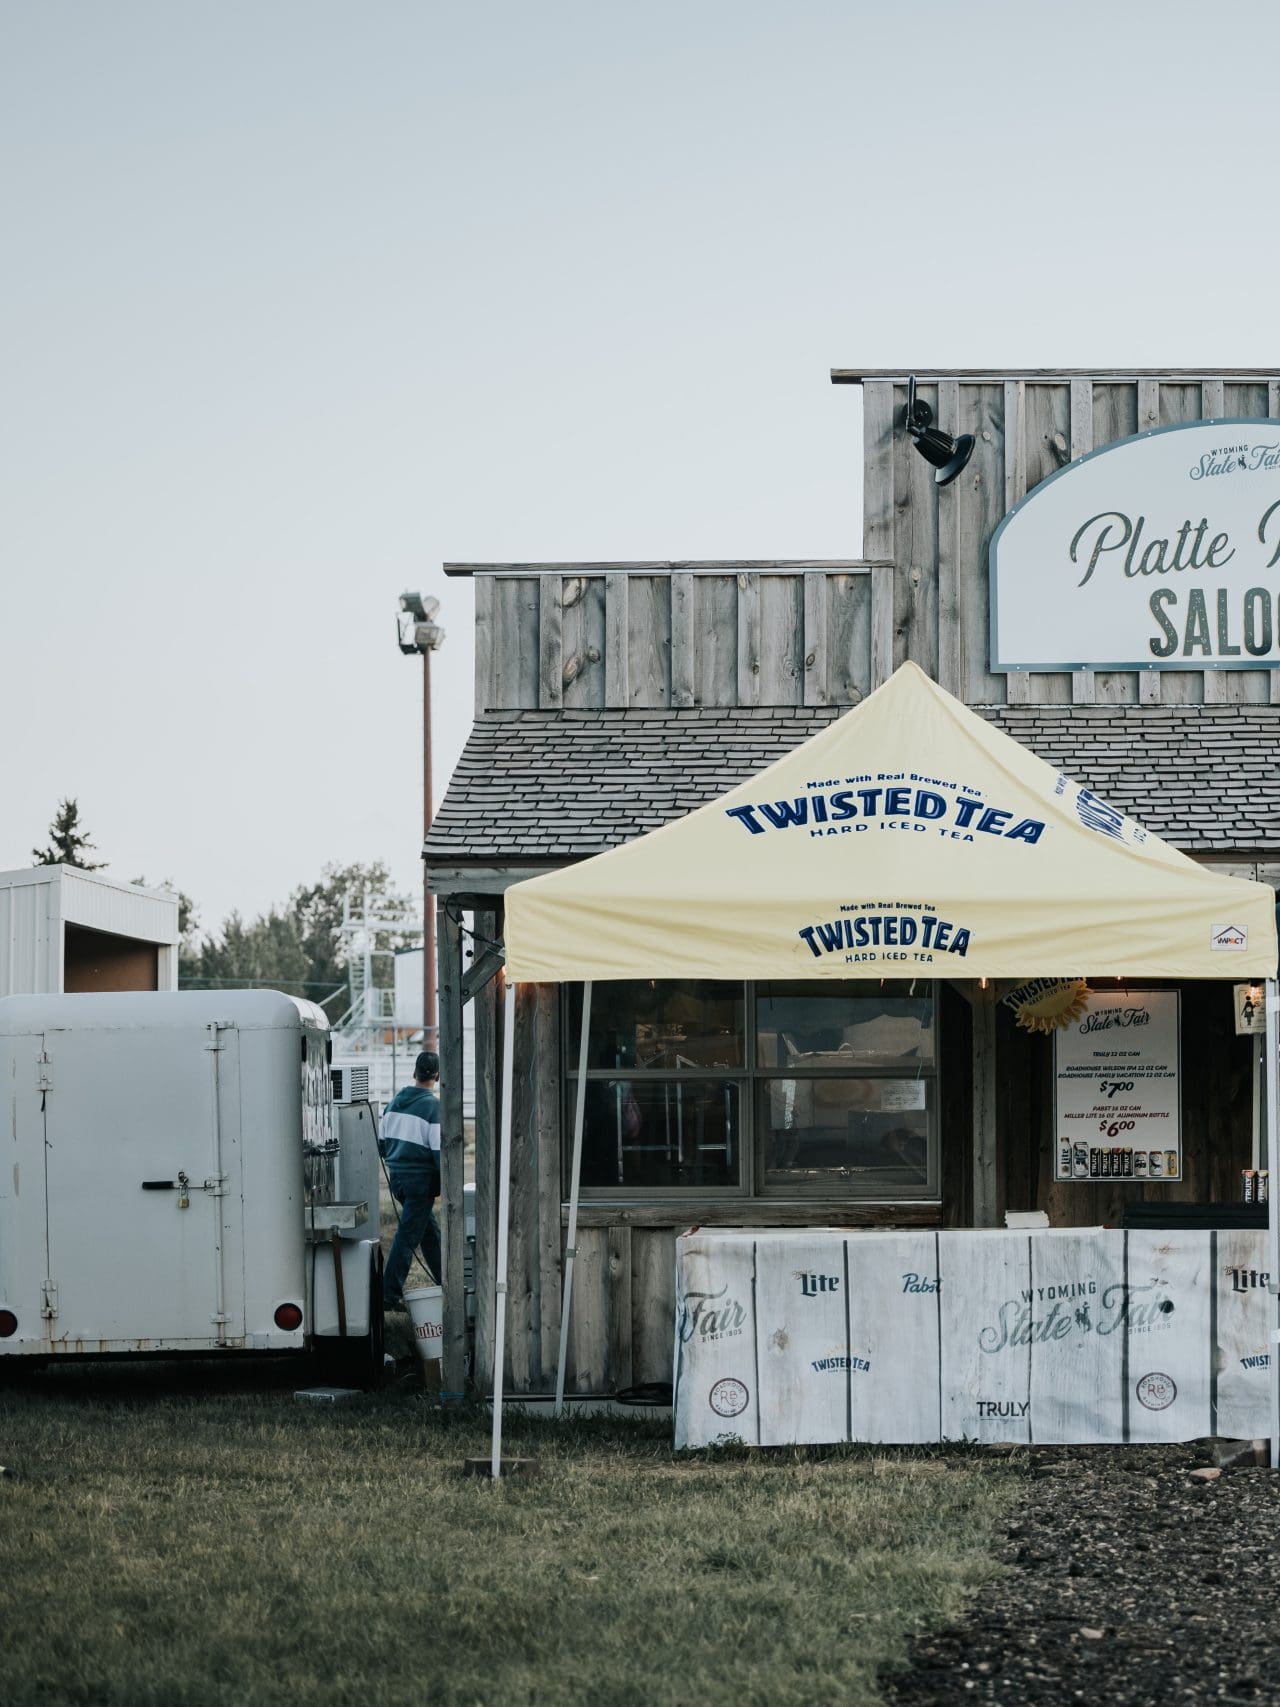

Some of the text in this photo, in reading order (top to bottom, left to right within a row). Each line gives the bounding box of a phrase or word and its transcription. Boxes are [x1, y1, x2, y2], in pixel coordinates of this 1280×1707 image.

[1210, 444, 1249, 456] WYOMING
[1189, 453, 1237, 480] State
[1069, 510, 1235, 587] Platte
[806, 773, 982, 797] Made with Real Brewed Tea
[725, 787, 947, 835] TWISTED
[955, 796, 1046, 845] TEA
[810, 821, 974, 842] HARD ICED TEA
[840, 904, 859, 912] Made
[860, 902, 876, 910] with
[896, 902, 922, 911] Brewed
[924, 903, 936, 912] Tea
[799, 915, 971, 958] TWISTED TEA
[845, 952, 933, 963] HARD ICED TEA
[1004, 977, 1060, 1011] TWISTED
[1079, 1006, 1151, 1034] State Fair
[1094, 1008, 1122, 1016] WYOMING
[1244, 1175, 1253, 1203] TRULY
[800, 1273, 840, 1298] Lite
[902, 1272, 944, 1294] Pabst
[1231, 1268, 1271, 1293] Lite
[1022, 1281, 1097, 1303] WYOMING
[680, 1283, 747, 1343] Fair
[701, 1332, 724, 1343] SINCE
[978, 1300, 1073, 1354] State
[1128, 1326, 1152, 1335] SINCE
[811, 1356, 871, 1373] TWISTED TEA
[1240, 1354, 1271, 1370] TWIST
[720, 1390, 738, 1403] RB
[976, 1401, 1030, 1417] TRULY
